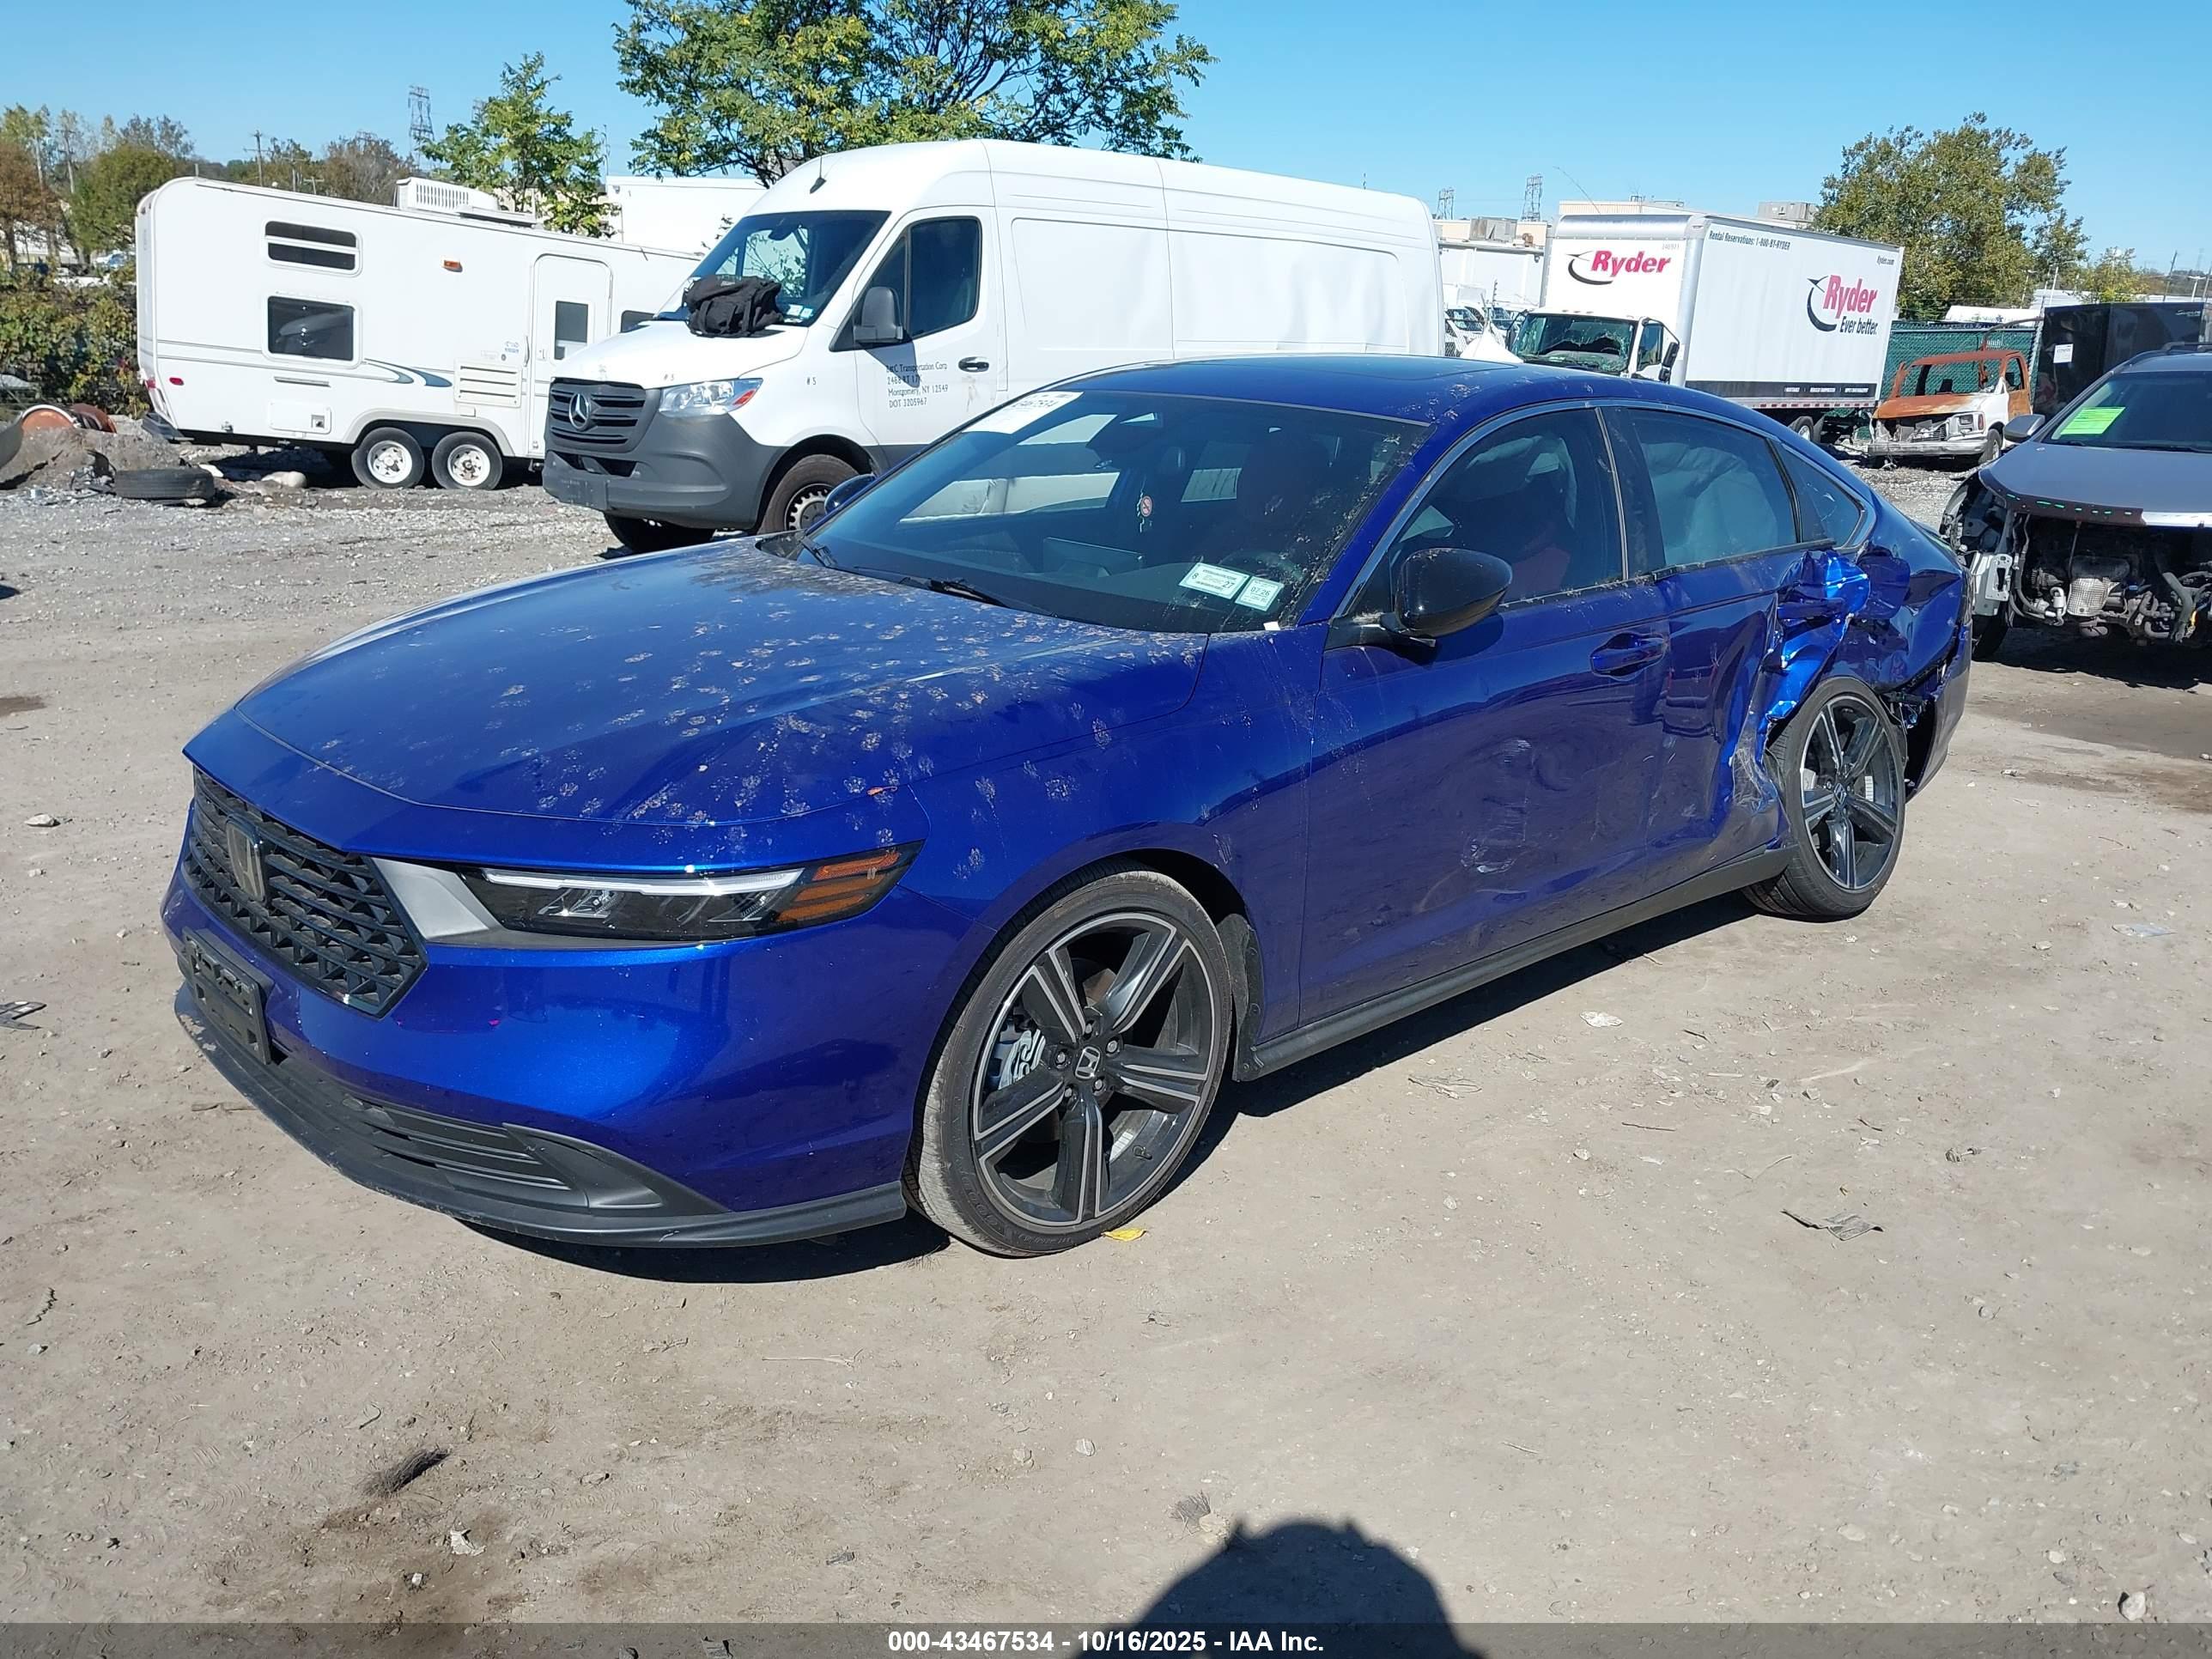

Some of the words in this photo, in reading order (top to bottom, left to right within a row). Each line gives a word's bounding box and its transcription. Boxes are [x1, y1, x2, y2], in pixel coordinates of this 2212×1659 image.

[1709, 230, 1724, 240] Rental
[1724, 232, 1755, 246] Reservations:
[1591, 251, 1672, 277] Ryder
[1823, 274, 1878, 319] Ryder
[1839, 316, 1856, 333] Ever
[1856, 318, 1878, 335] better.
[900, 362, 934, 373] Transportation
[935, 361, 948, 371] Corp
[932, 385, 949, 393] 12549
[889, 399, 902, 409] DOT
[903, 397, 927, 407] 3205967
[1222, 580, 1236, 589] 27
